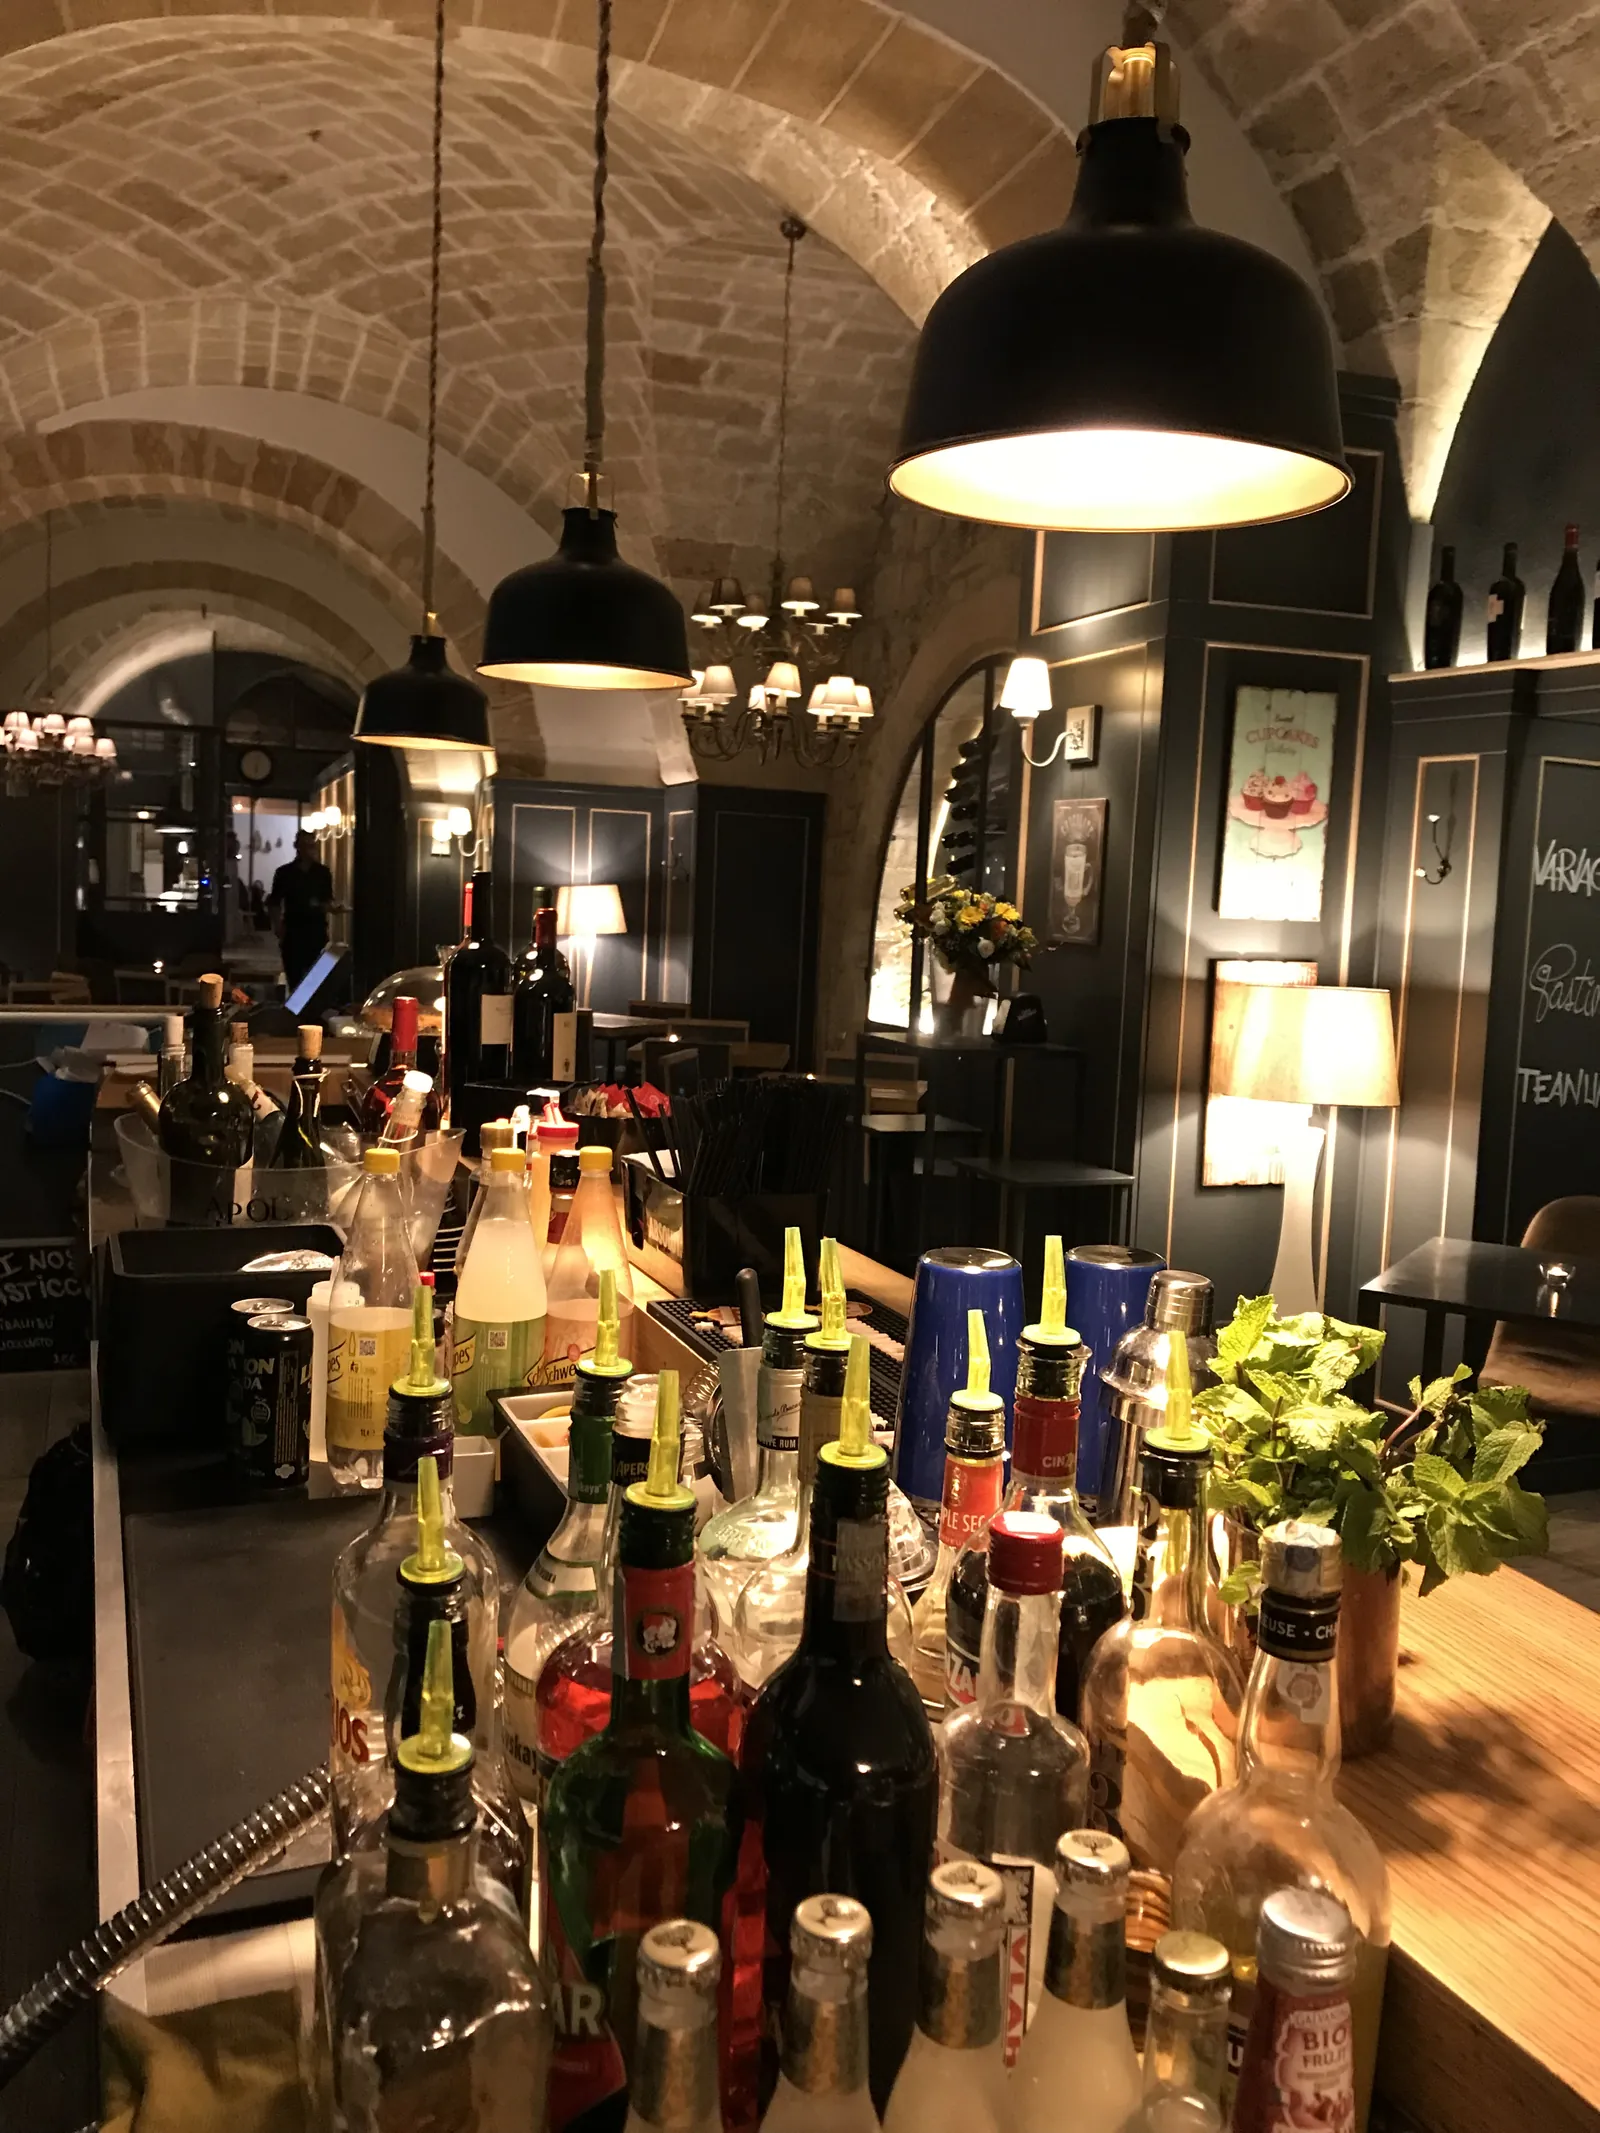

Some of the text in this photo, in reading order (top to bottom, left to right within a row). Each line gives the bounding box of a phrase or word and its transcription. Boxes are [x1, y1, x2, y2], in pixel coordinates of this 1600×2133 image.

[1246, 726, 1320, 749] CUPCAKES
[1517, 1067, 1600, 1109] TEANU
[779, 1438, 796, 1449] RUM
[1303, 2024, 1347, 2050] BIO
